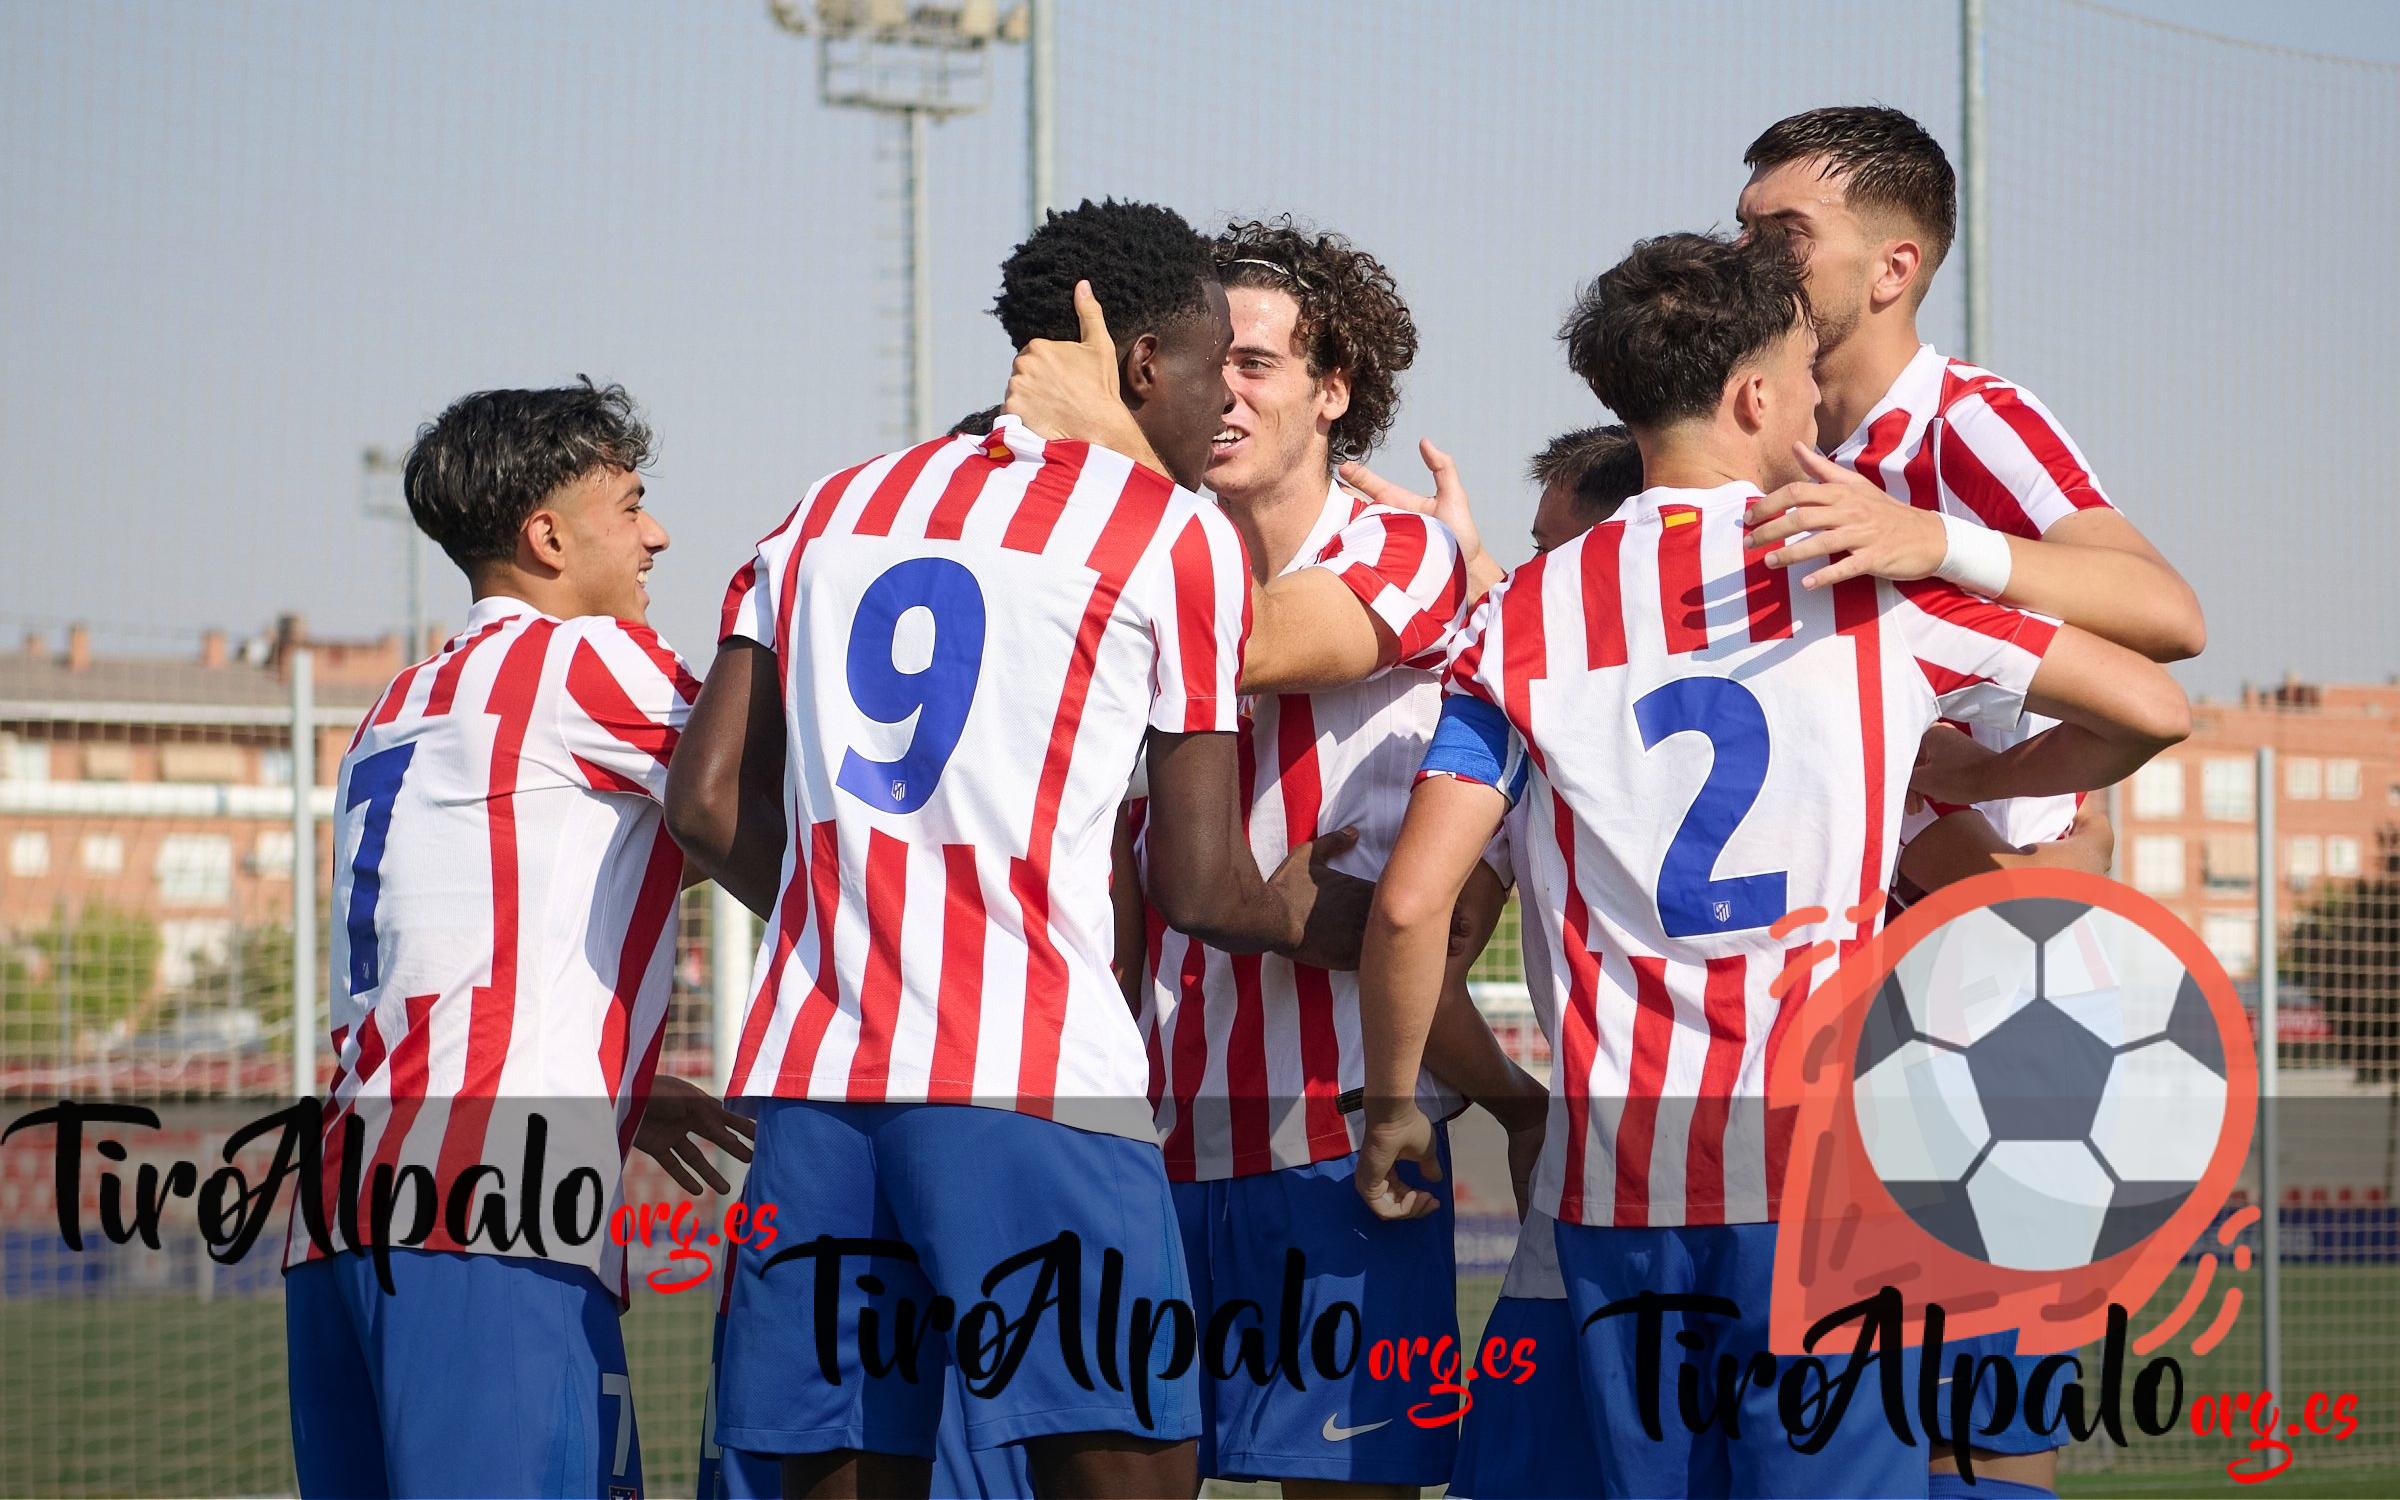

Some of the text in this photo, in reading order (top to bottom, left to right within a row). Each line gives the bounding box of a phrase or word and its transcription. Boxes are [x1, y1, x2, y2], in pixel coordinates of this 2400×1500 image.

[836, 557, 986, 814] 9
[1633, 676, 1788, 938] 2
[346, 741, 417, 997] 7
[602, 1372, 632, 1477] 7
